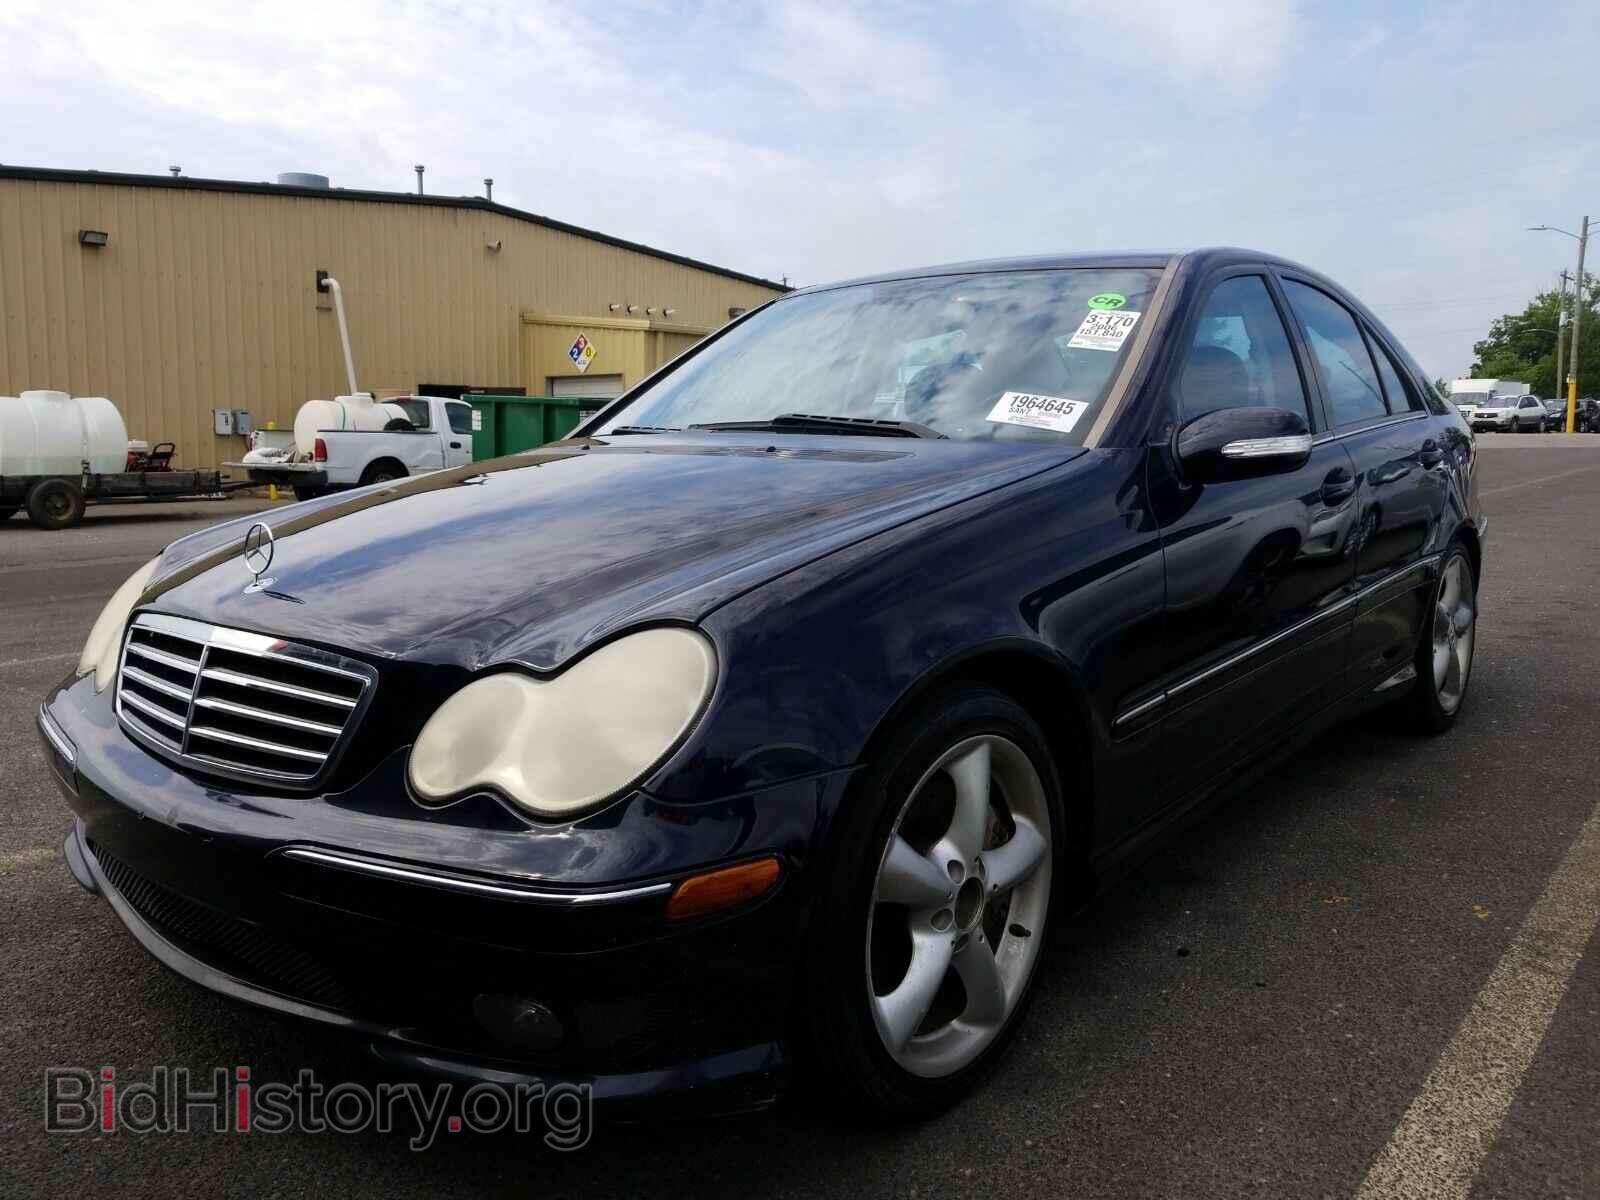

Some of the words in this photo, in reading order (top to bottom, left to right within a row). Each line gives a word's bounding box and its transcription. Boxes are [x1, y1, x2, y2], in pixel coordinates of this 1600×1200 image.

[1093, 296, 1123, 307] CR
[572, 347, 578, 358] 2
[1009, 395, 1077, 415] 1964645
